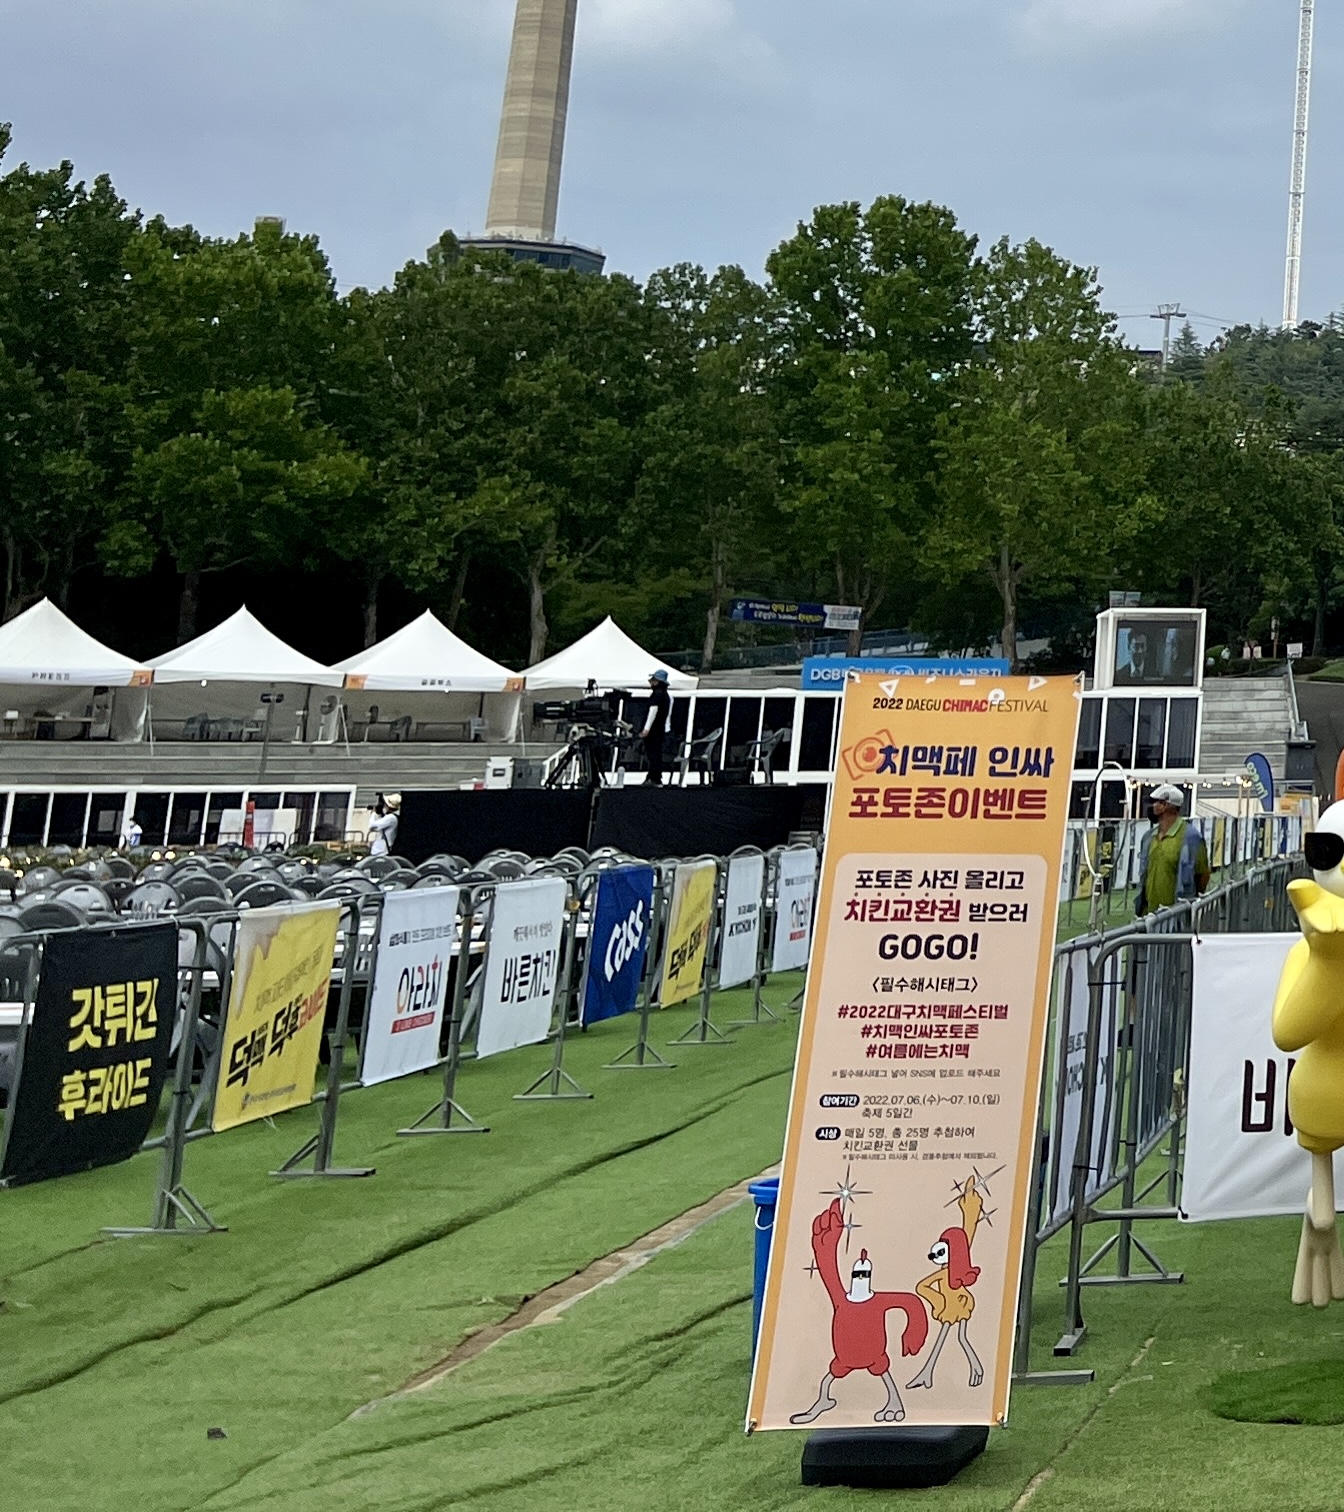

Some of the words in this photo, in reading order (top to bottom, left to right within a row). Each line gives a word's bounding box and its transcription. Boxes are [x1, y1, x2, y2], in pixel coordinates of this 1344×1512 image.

[873, 697, 904, 710] 2022
[876, 745, 977, 777] 치맥페
[988, 746, 1055, 778] 인싸
[848, 787, 1048, 820] 포토존이벤트
[855, 869, 913, 889] 포토존
[917, 869, 959, 889] 사진
[964, 870, 1025, 890] 올리고
[844, 898, 961, 922] 치킨교환권
[969, 903, 1028, 923] 받으러
[878, 933, 979, 960] GOGO!
[500, 949, 556, 1005] 바른치킨
[67, 977, 159, 1053] 갓튀긴
[837, 1004, 1009, 1020] #2022대구치맥페스티벌
[860, 1023, 980, 1039] #치맥인싸포토존
[865, 1043, 970, 1059] #여름에는치맥
[57, 1057, 152, 1121] 후라이드
[885, 1108, 913, 1119] 5일간
[818, 1128, 838, 1139] 시상
[844, 1127, 865, 1138] 매일
[906, 1127, 930, 1138] 25명
[933, 1127, 975, 1138] 추첨하여
[842, 1140, 894, 1152] 치킨교환권
[898, 1140, 918, 1152] 선물
